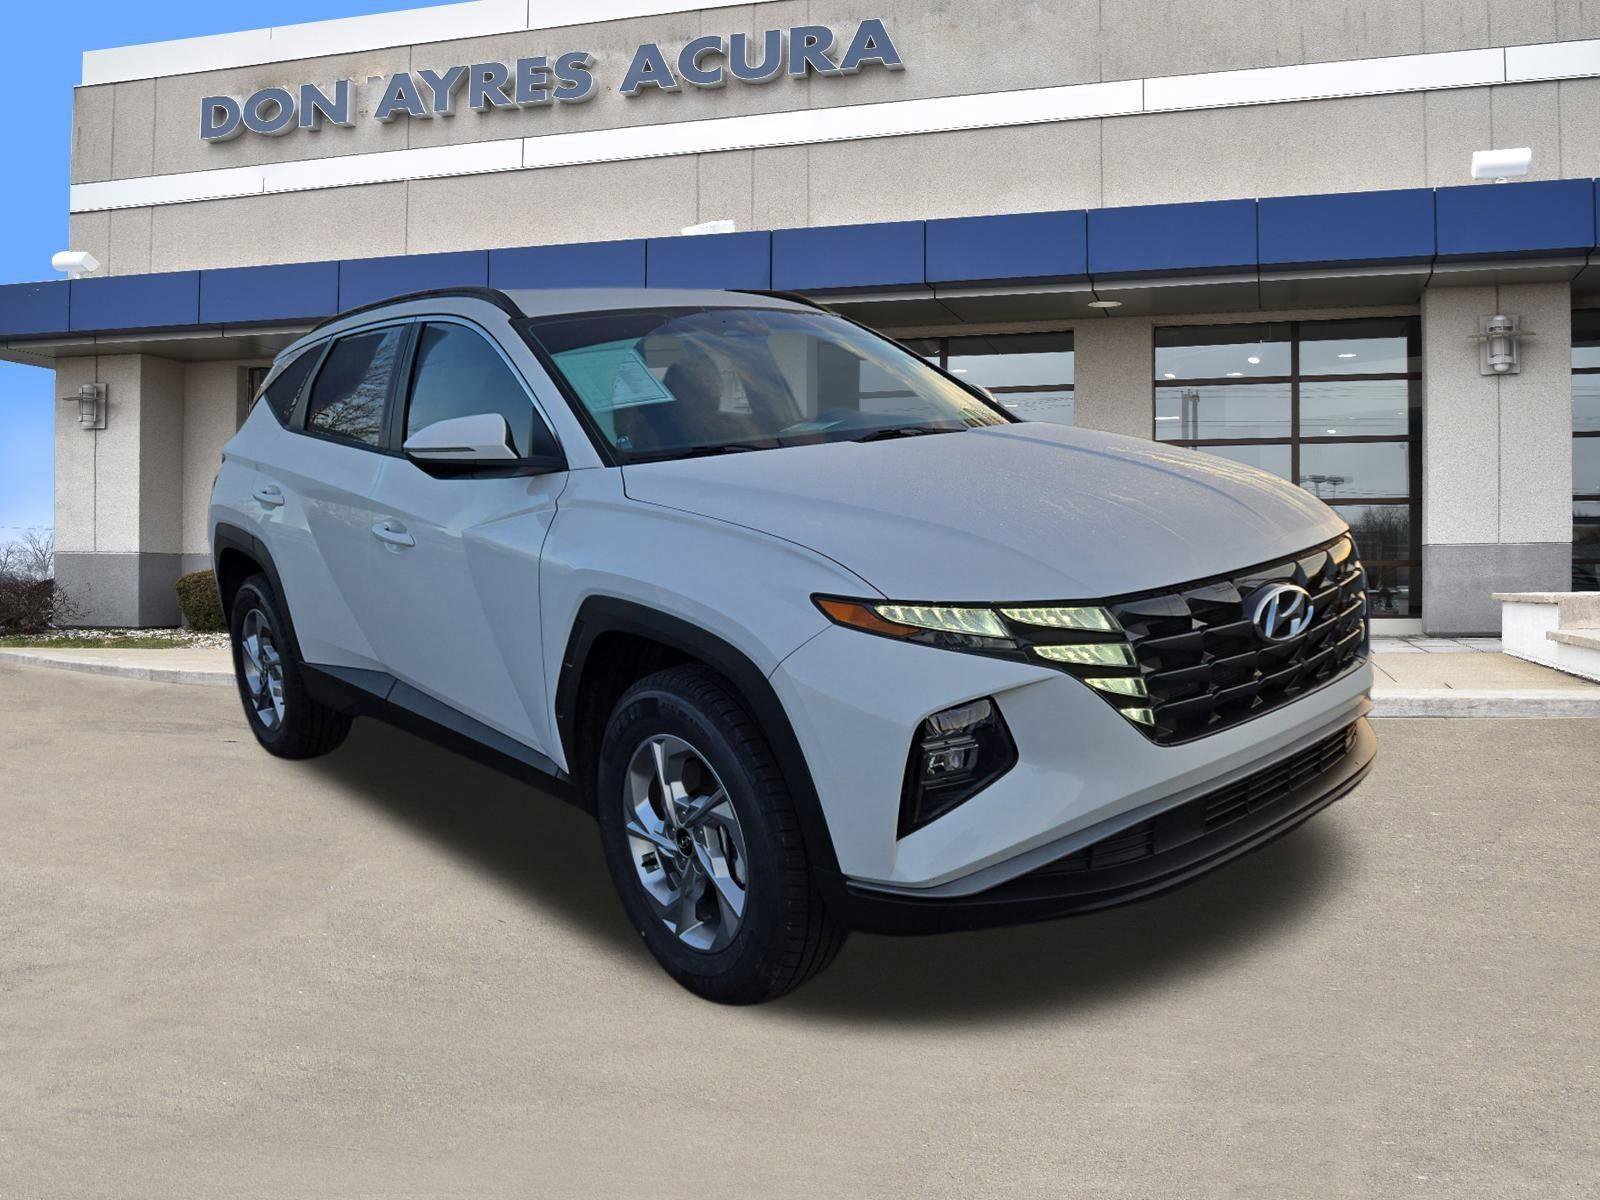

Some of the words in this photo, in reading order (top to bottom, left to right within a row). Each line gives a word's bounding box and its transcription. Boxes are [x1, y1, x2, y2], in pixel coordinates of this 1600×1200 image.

[200, 79, 353, 142] DON
[374, 51, 595, 121] AYRES
[619, 17, 904, 95] ACURA
